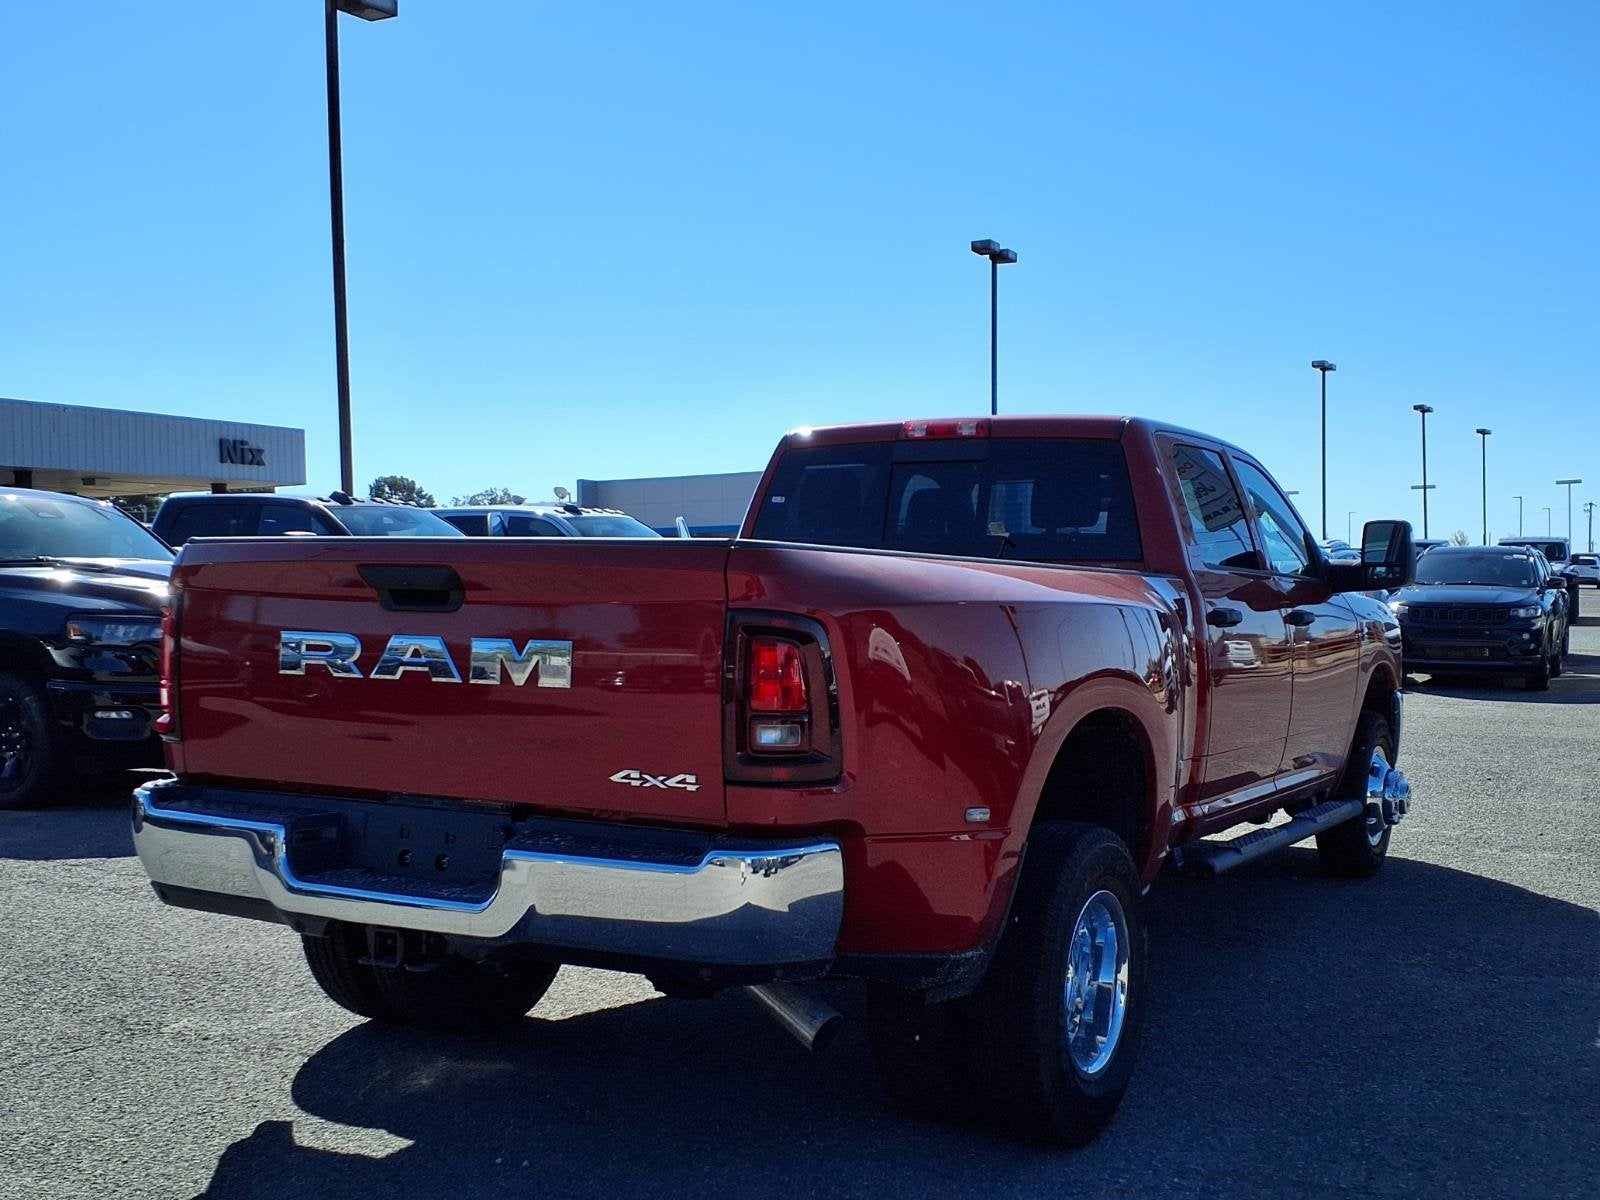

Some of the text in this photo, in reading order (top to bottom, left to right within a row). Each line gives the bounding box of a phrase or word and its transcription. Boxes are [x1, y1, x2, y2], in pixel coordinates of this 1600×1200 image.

[219, 439, 266, 466] Nix
[279, 630, 573, 688] RAM
[609, 769, 702, 792] 4x4
